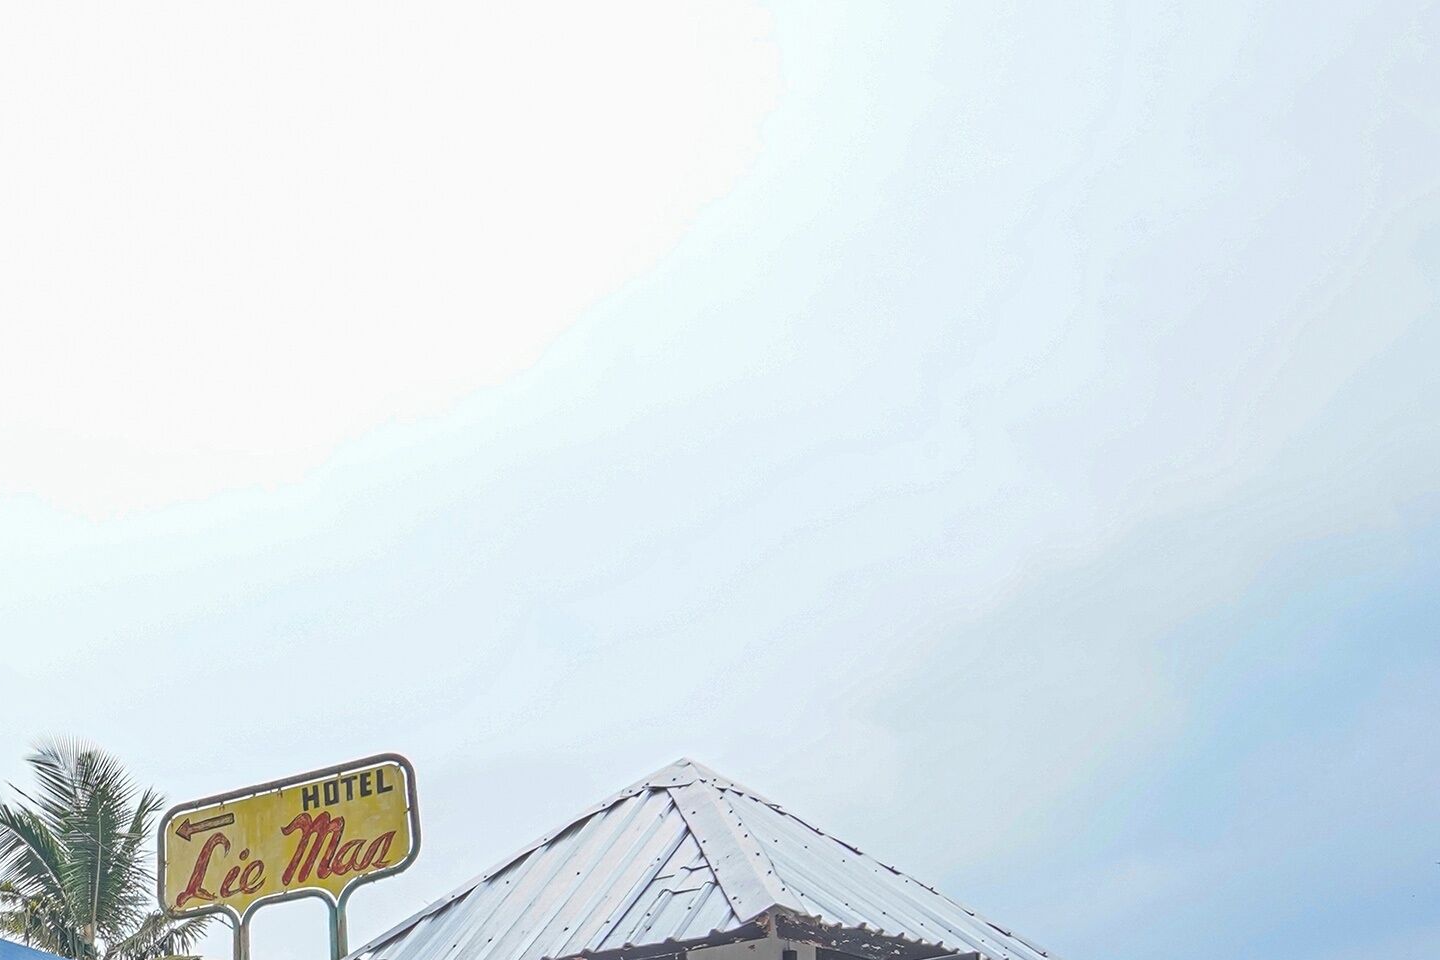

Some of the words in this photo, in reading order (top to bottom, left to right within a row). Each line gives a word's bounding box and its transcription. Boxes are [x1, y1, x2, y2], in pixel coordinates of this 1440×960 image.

[302, 768, 394, 811] HOTEL
[175, 832, 267, 908] Lie
[281, 811, 397, 887] Man
